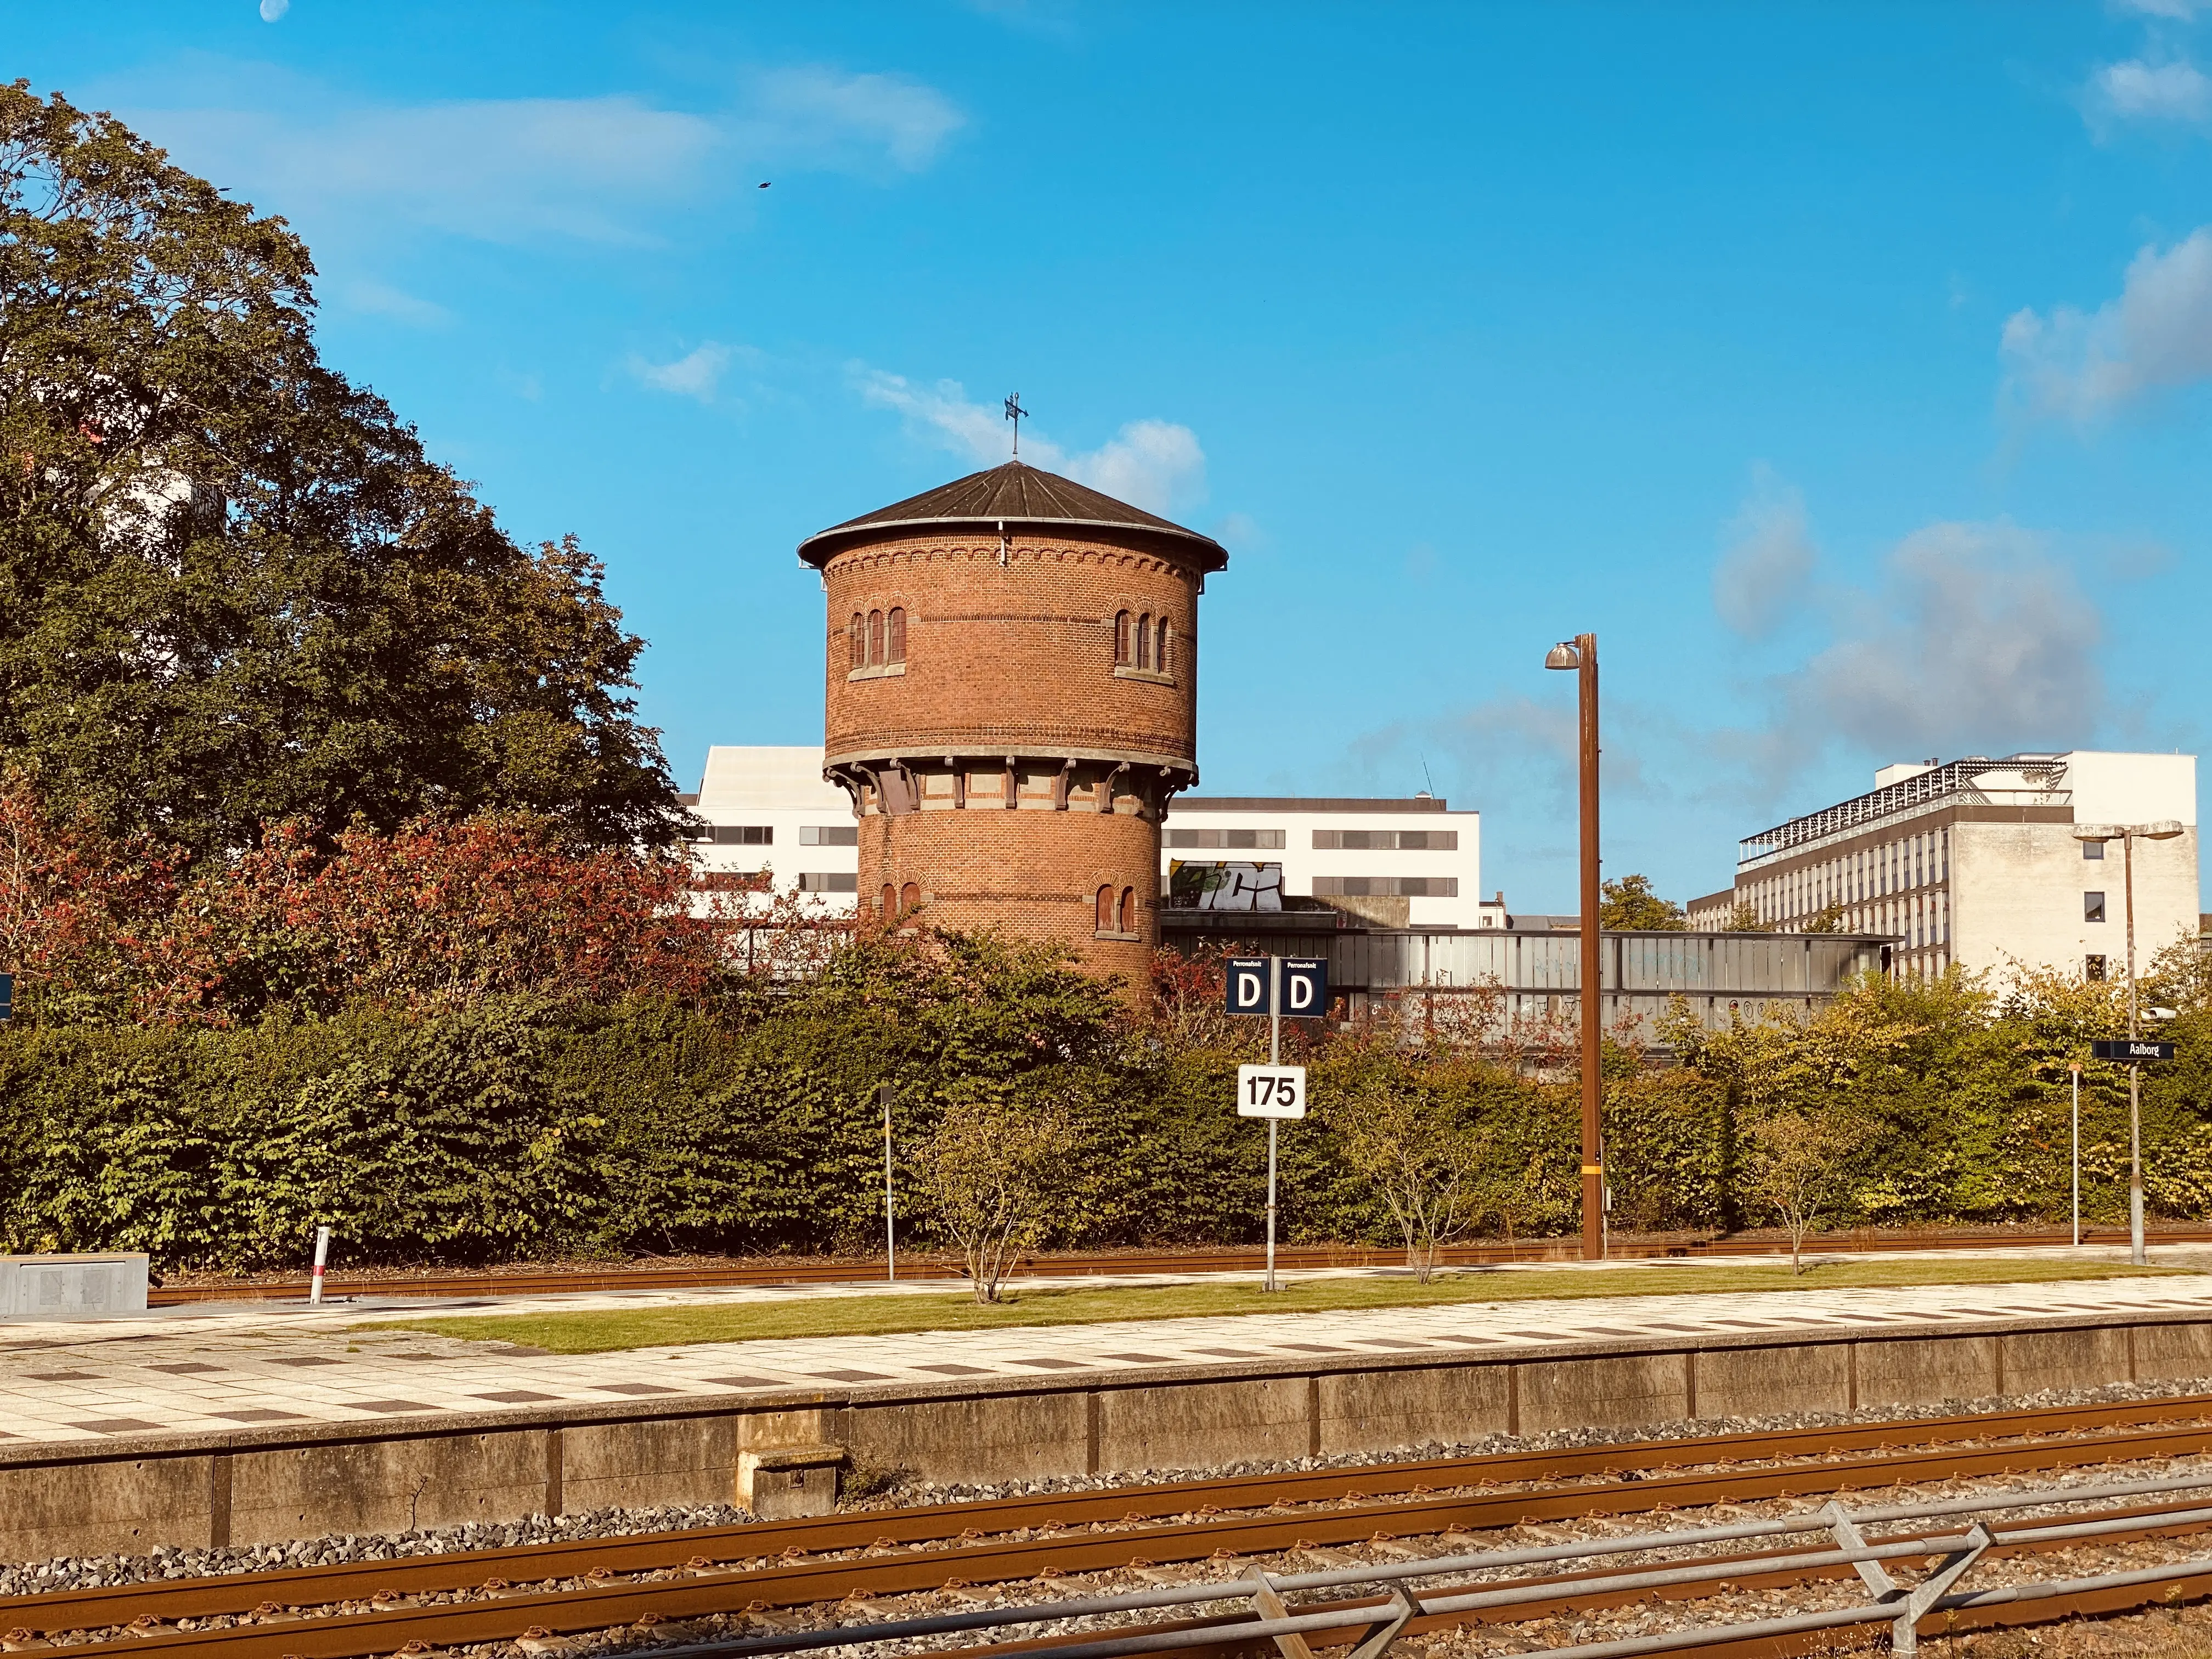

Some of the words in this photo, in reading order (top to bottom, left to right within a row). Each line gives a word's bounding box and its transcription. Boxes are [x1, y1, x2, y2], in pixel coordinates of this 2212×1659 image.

[1239, 973, 1260, 1007] D
[1291, 975, 1312, 1008] D
[2130, 1043, 2159, 1057] Aalborg
[1248, 1076, 1295, 1107] 175
